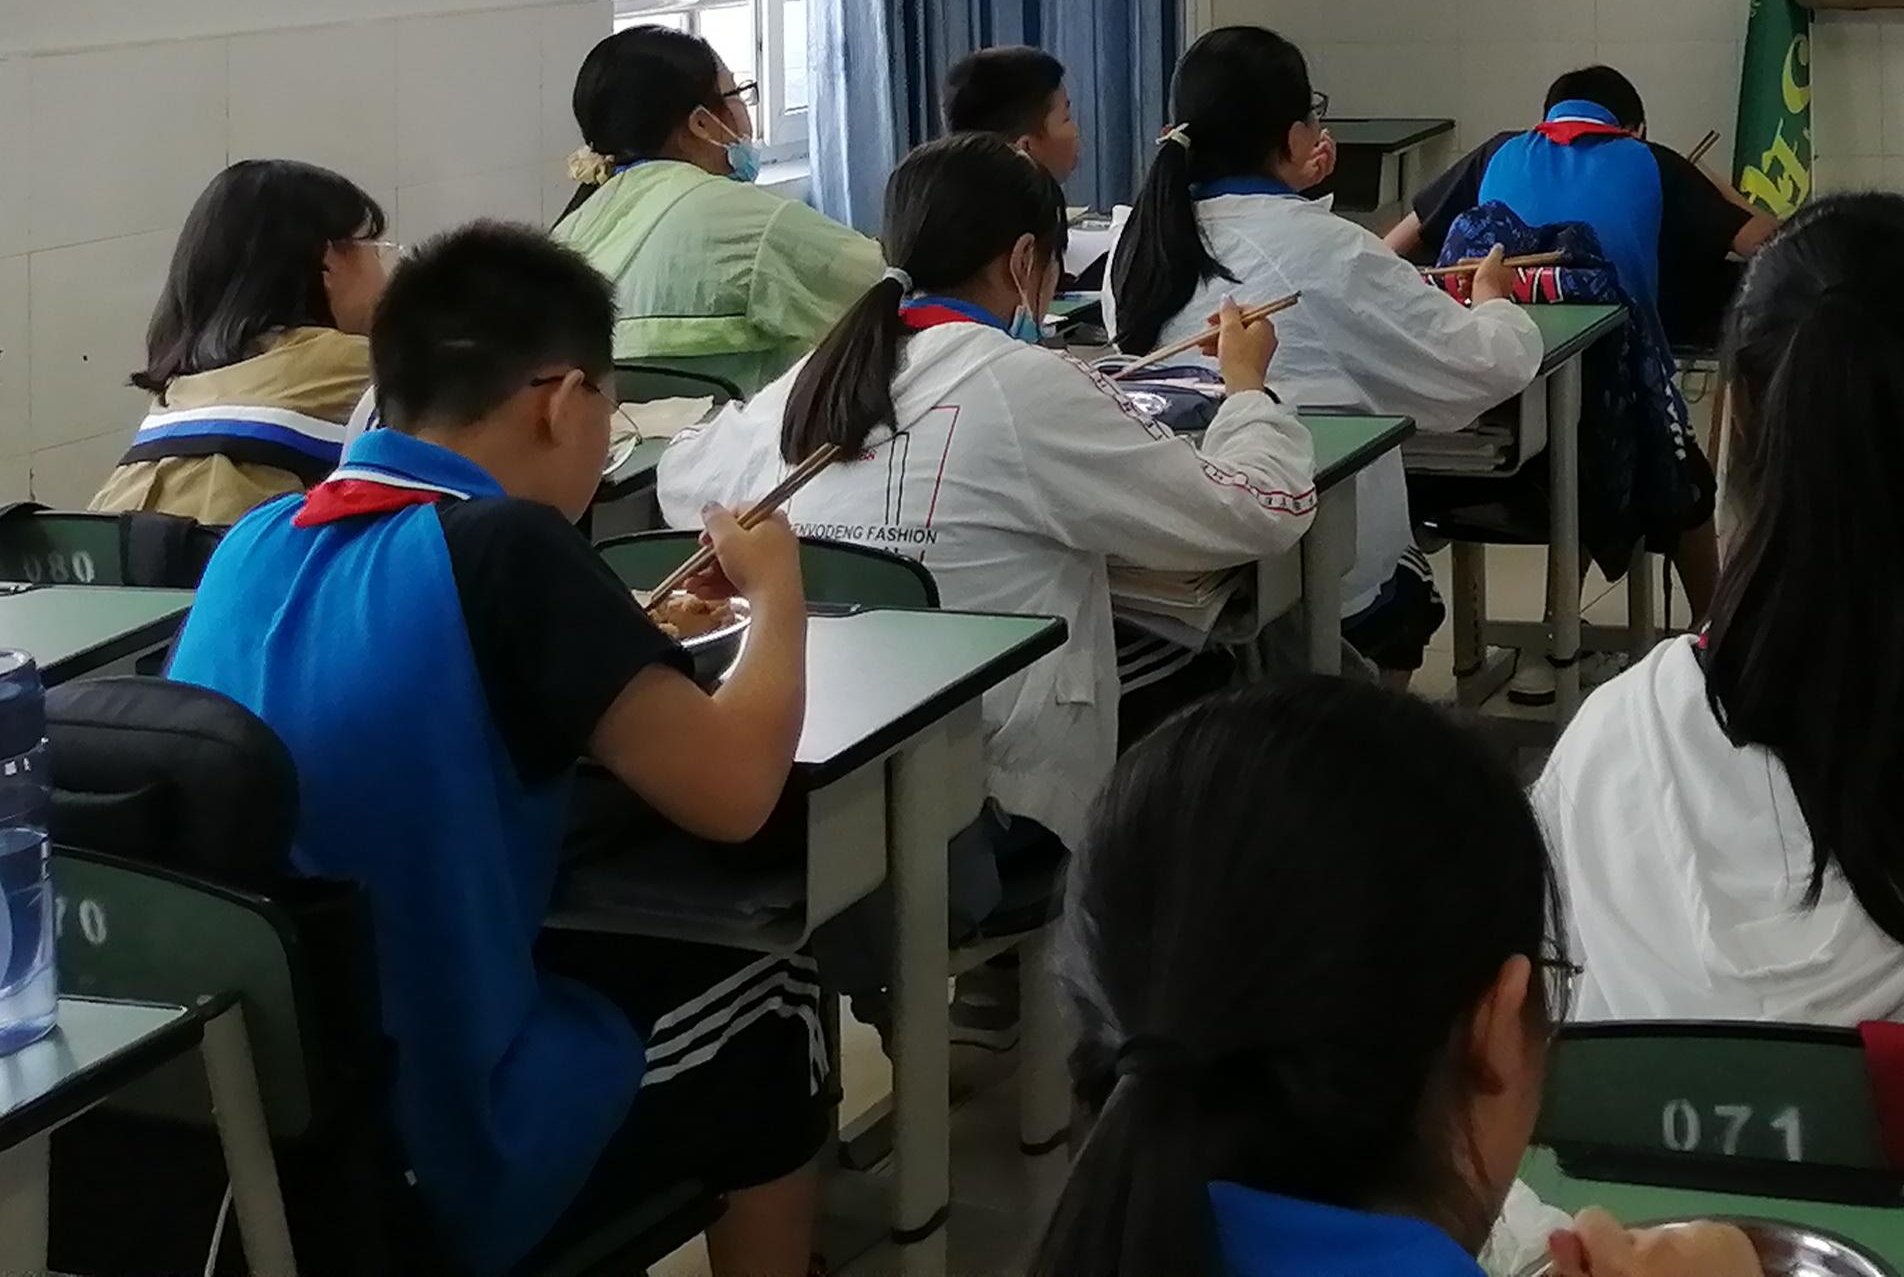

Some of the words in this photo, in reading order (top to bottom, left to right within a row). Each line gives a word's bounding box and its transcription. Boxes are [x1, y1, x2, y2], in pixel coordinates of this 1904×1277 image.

[867, 526, 938, 545] FASHION
[24, 550, 95, 583] 080
[1661, 1098, 1807, 1163] 071
